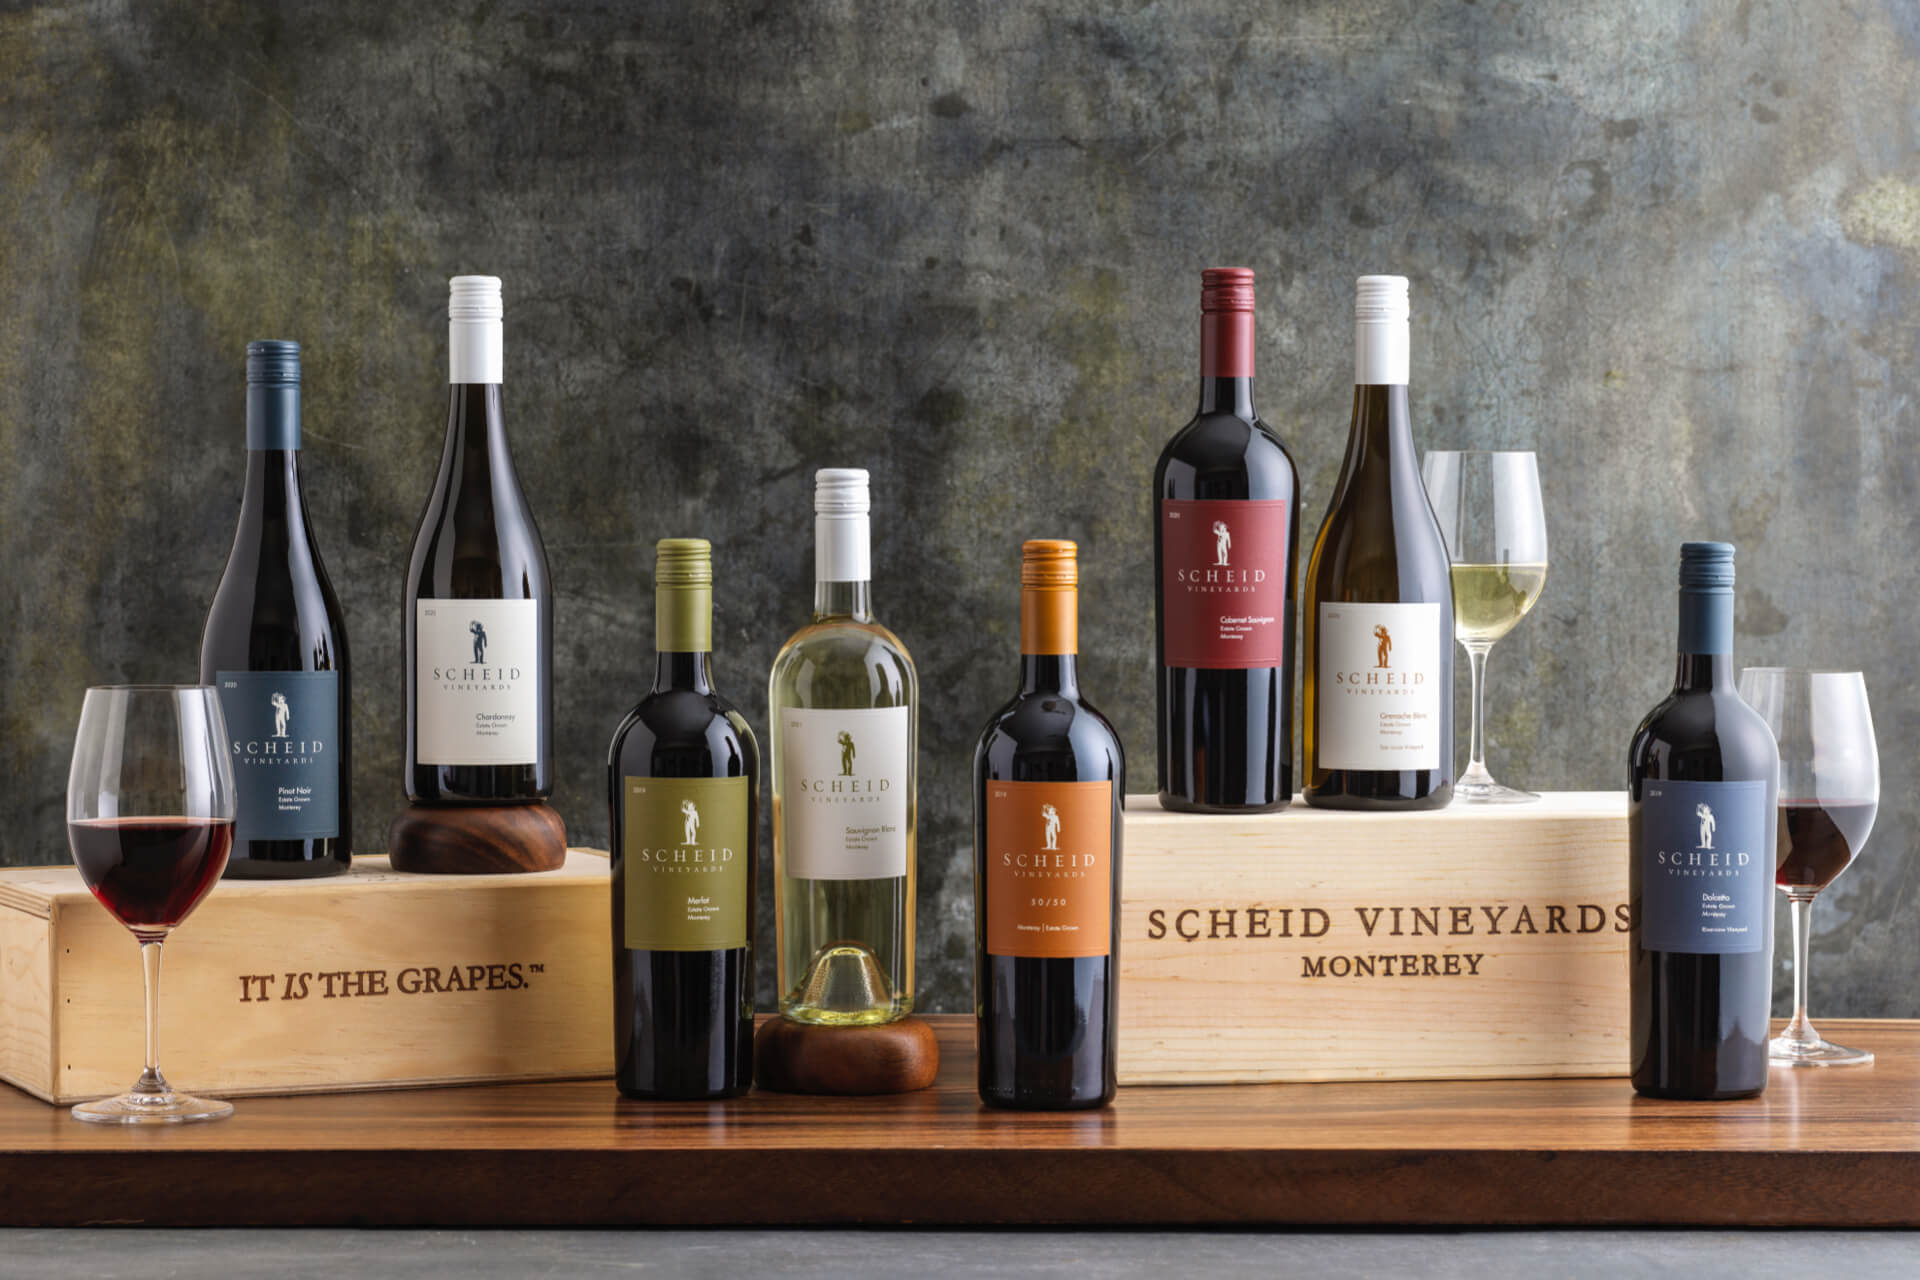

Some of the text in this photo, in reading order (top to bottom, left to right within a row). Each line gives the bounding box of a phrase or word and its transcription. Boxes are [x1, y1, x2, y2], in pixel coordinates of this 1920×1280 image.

[1178, 569, 1265, 583] SCHEID
[1221, 616, 1246, 624] Cabernet
[434, 668, 520, 680] SCHEID
[1337, 672, 1424, 685] SCHEID
[476, 713, 515, 721] Chardonnay
[233, 741, 323, 754] SCHEID
[801, 779, 890, 792] SCHEID
[846, 827, 879, 835] Sauvignon
[642, 848, 733, 862] SCHEID
[1003, 853, 1095, 867] SCHEID
[1658, 851, 1750, 866] SCHEID
[688, 896, 709, 904] Merlot
[1703, 893, 1730, 901] Dolcetto
[1148, 904, 1631, 939] SCHEID VINEYARDS
[1301, 954, 1484, 977] MONTEREY
[239, 974, 275, 1002] IT
[281, 972, 313, 1000] IS
[318, 970, 388, 998] THE
